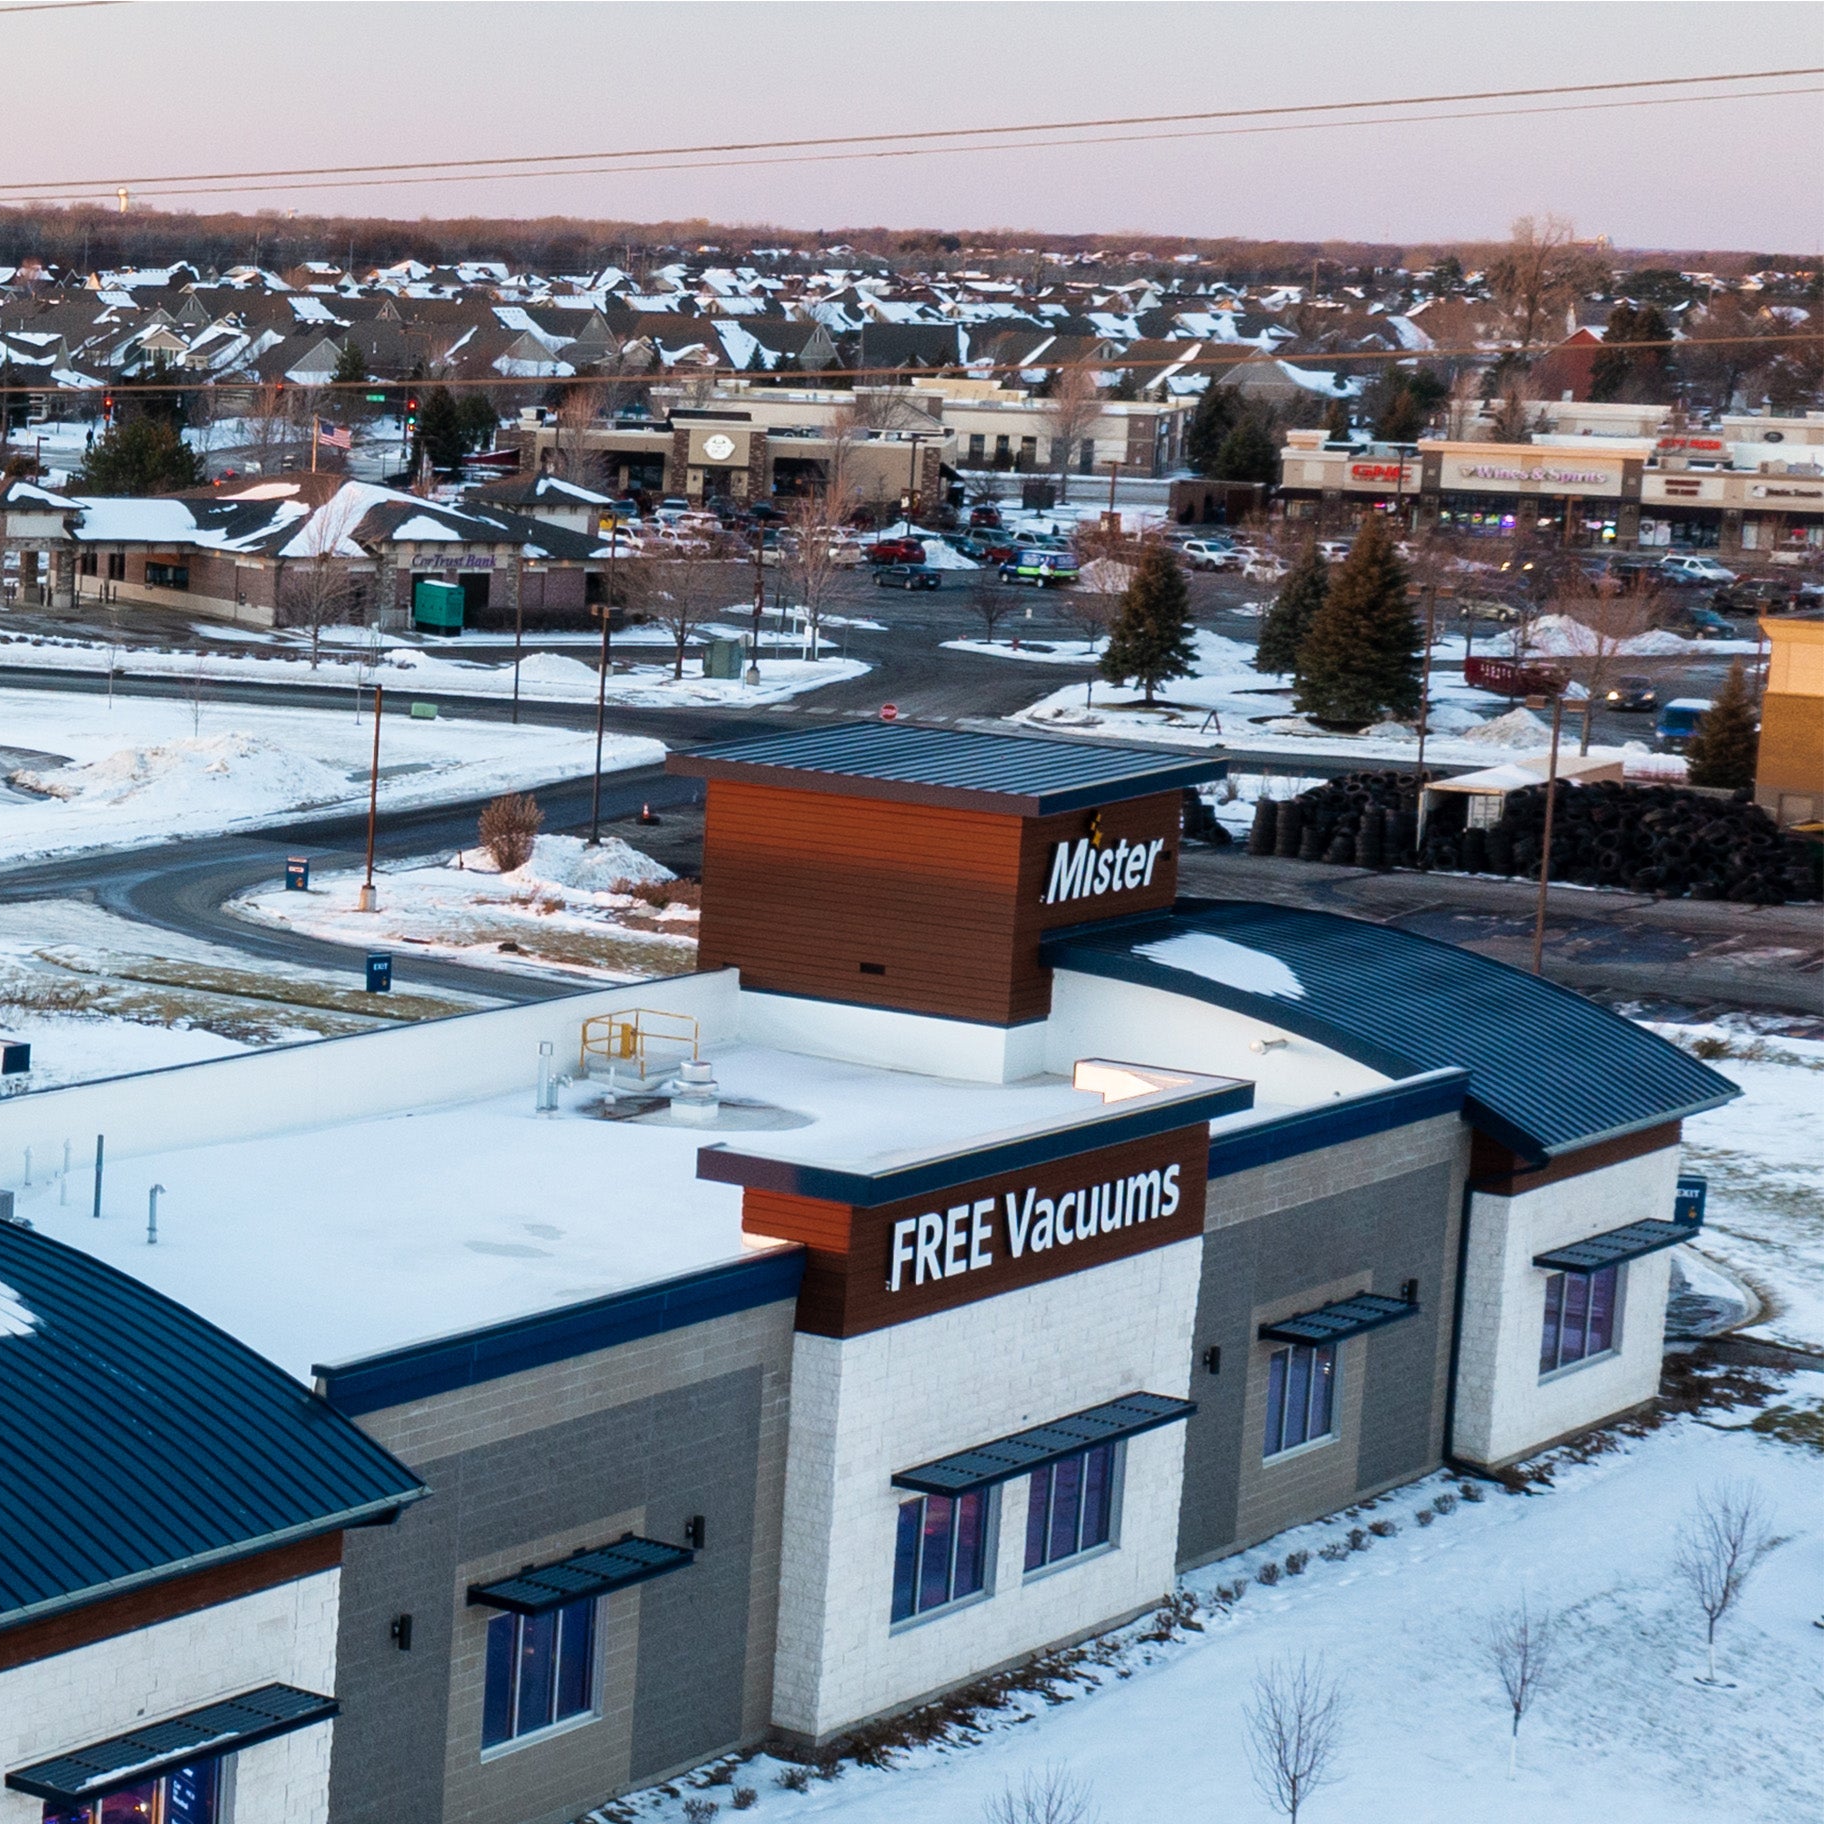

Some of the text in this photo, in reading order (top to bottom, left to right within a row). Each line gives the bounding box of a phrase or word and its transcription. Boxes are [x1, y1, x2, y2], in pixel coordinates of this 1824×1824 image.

[1353, 464, 1413, 479] GNC
[1477, 465, 1608, 485] Wines & Spirits
[466, 553, 497, 568] Bank
[1046, 838, 1163, 904] Mister
[892, 1163, 1180, 1292] FREE Vacuums
